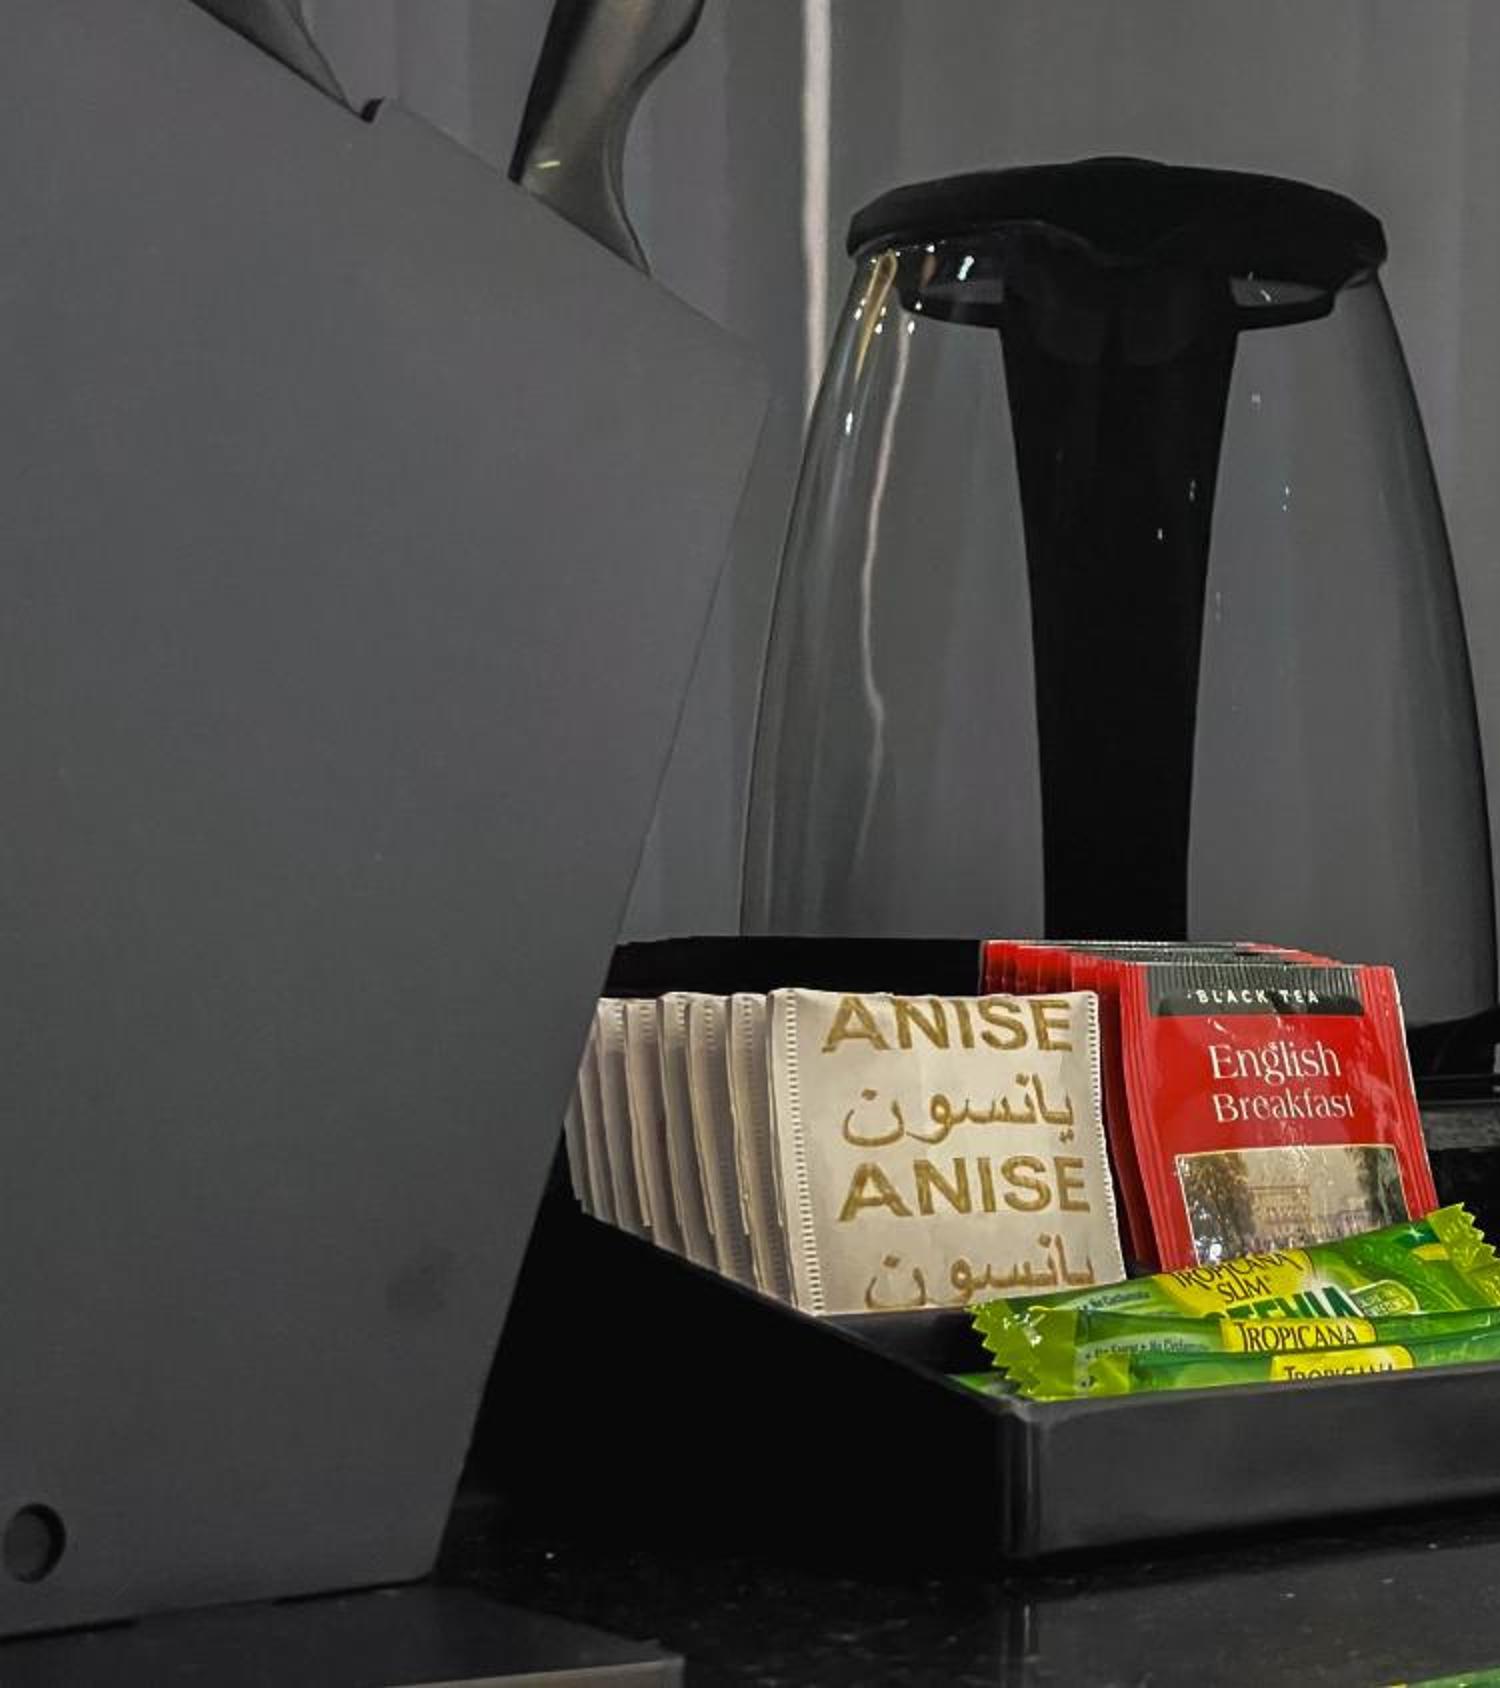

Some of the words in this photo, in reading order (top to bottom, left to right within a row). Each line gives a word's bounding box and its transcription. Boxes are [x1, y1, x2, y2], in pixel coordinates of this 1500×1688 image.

[1196, 988, 1269, 1005] BLACK
[1279, 988, 1320, 1005] TEA
[822, 996, 1073, 1053] ANISE
[1208, 1040, 1342, 1087] English
[842, 1073, 1075, 1147] يانسون
[1212, 1087, 1356, 1124] Breakfast
[838, 1155, 1091, 1222] ANISE
[1234, 1321, 1358, 1352] TROPICANA
